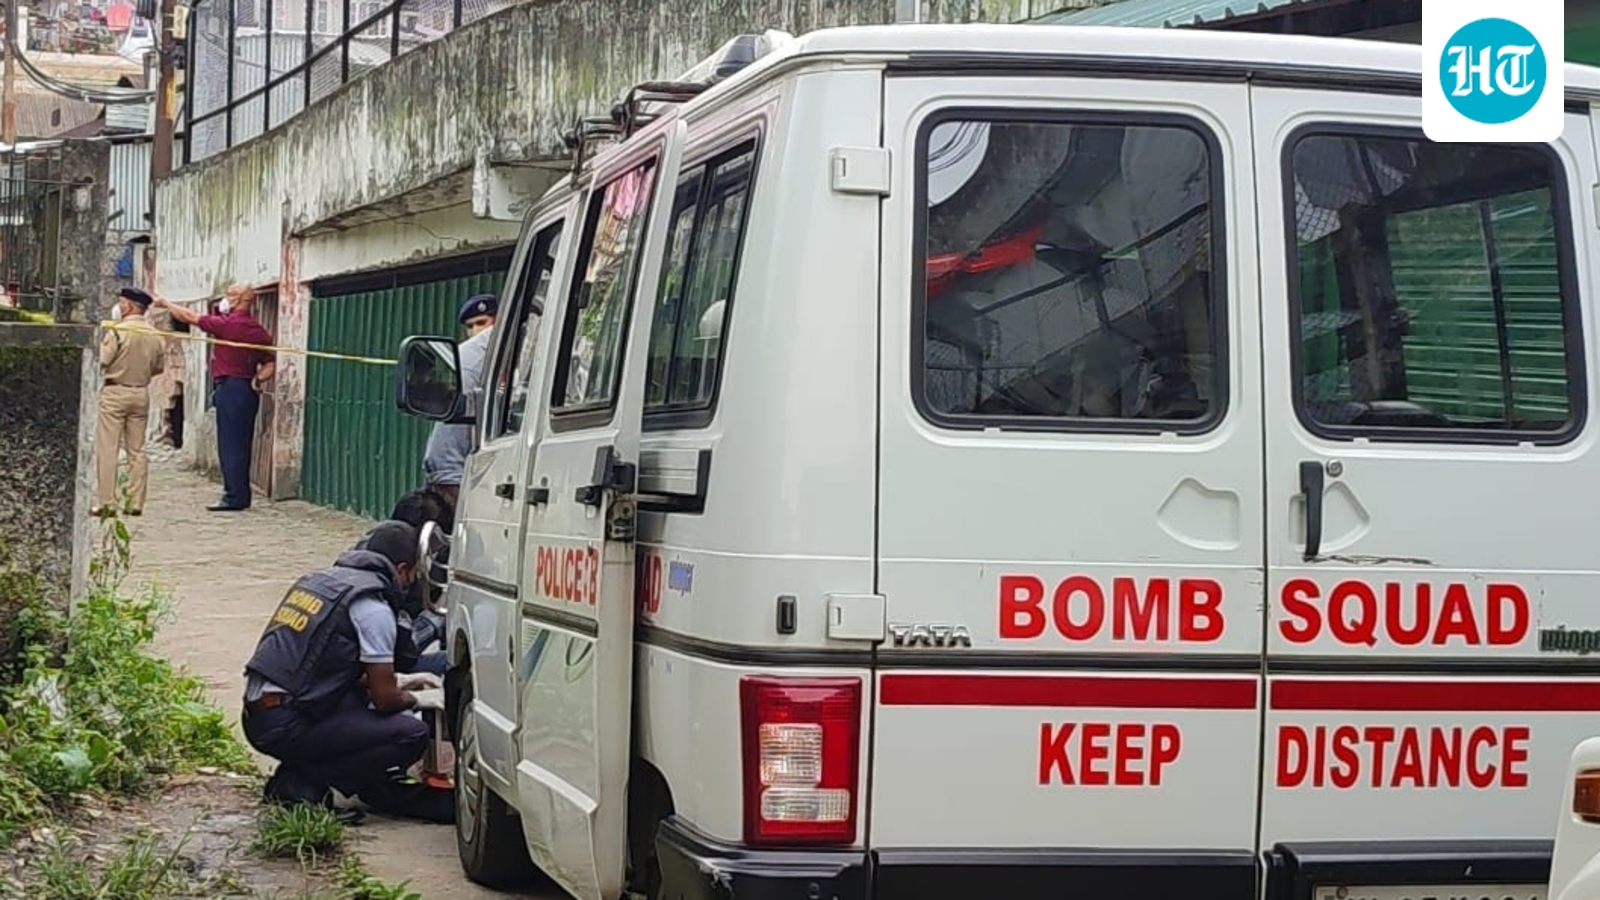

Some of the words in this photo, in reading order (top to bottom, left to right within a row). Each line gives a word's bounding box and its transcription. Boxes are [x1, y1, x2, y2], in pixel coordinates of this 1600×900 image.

[888, 623, 972, 648] TATA
[998, 574, 1226, 643] BOMB
[1278, 578, 1530, 648] SQUAD
[1038, 722, 1182, 787] KEEP
[1275, 724, 1531, 788] DISTANCE
